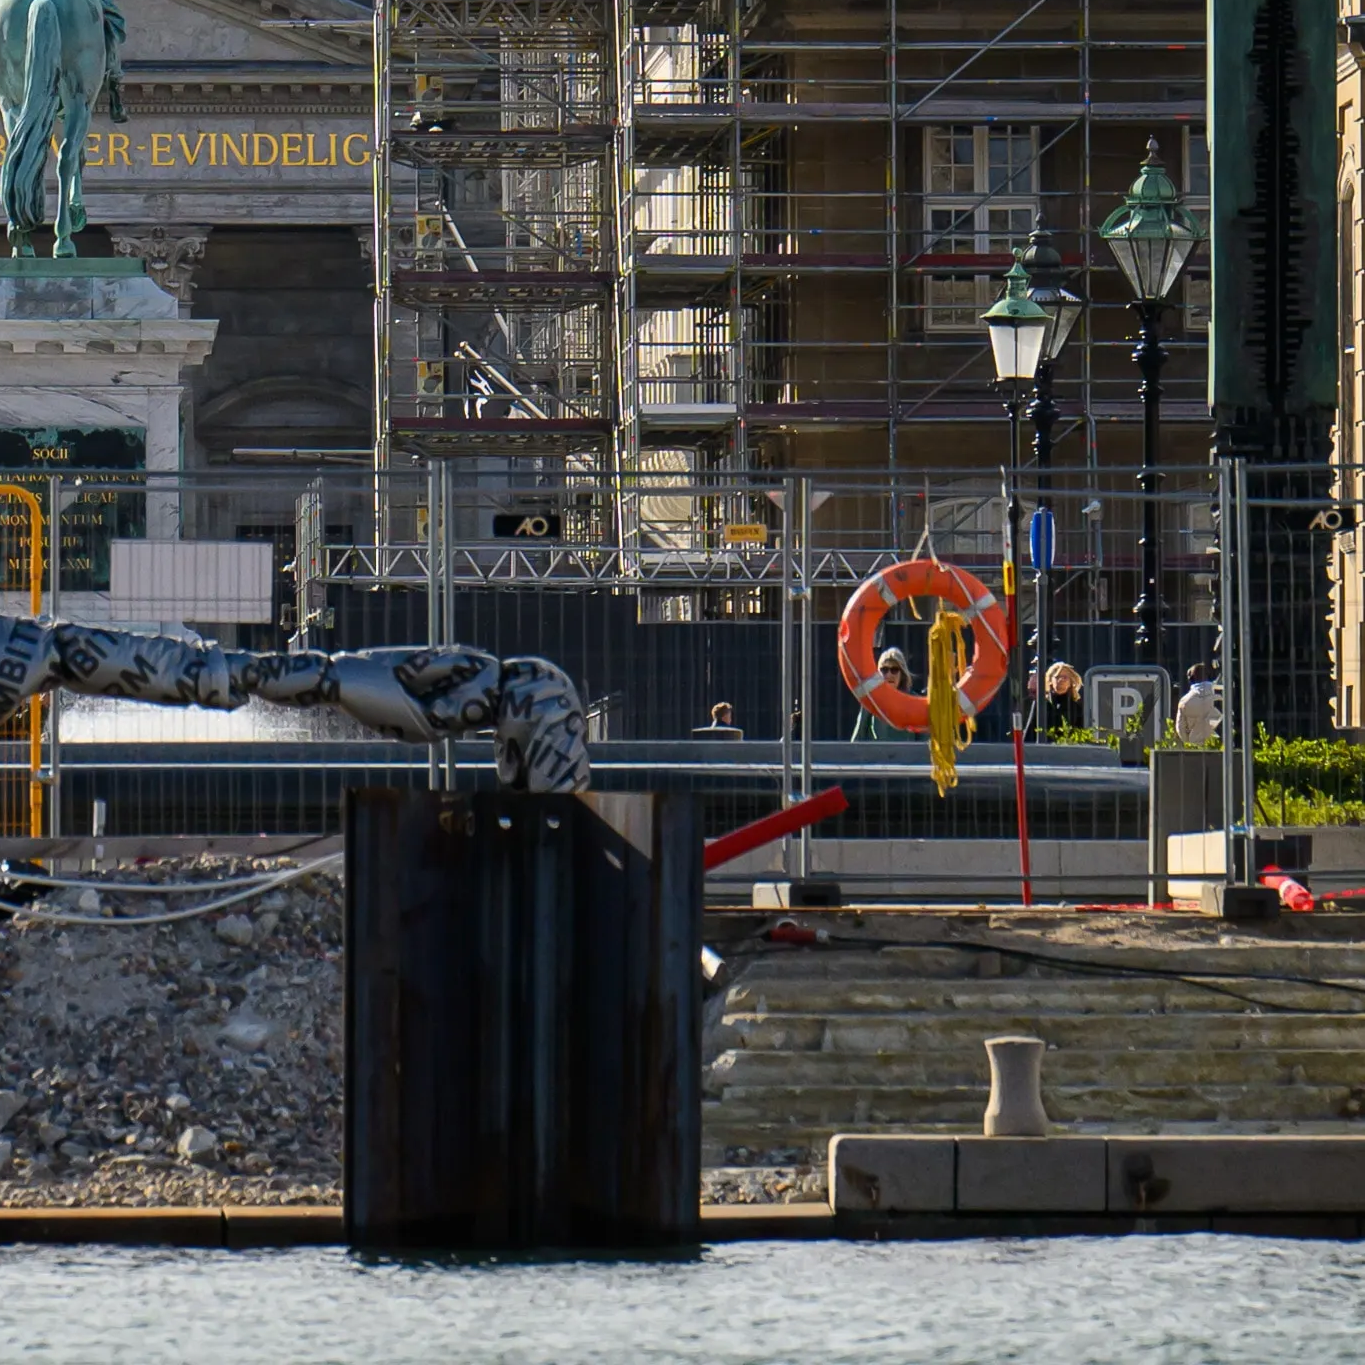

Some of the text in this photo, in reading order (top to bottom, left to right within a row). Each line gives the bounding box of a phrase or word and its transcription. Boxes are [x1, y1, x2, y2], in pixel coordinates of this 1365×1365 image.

[150, 133, 362, 166] EVINDELIG
[32, 447, 69, 460] SOCII
[1113, 687, 1144, 730] P
